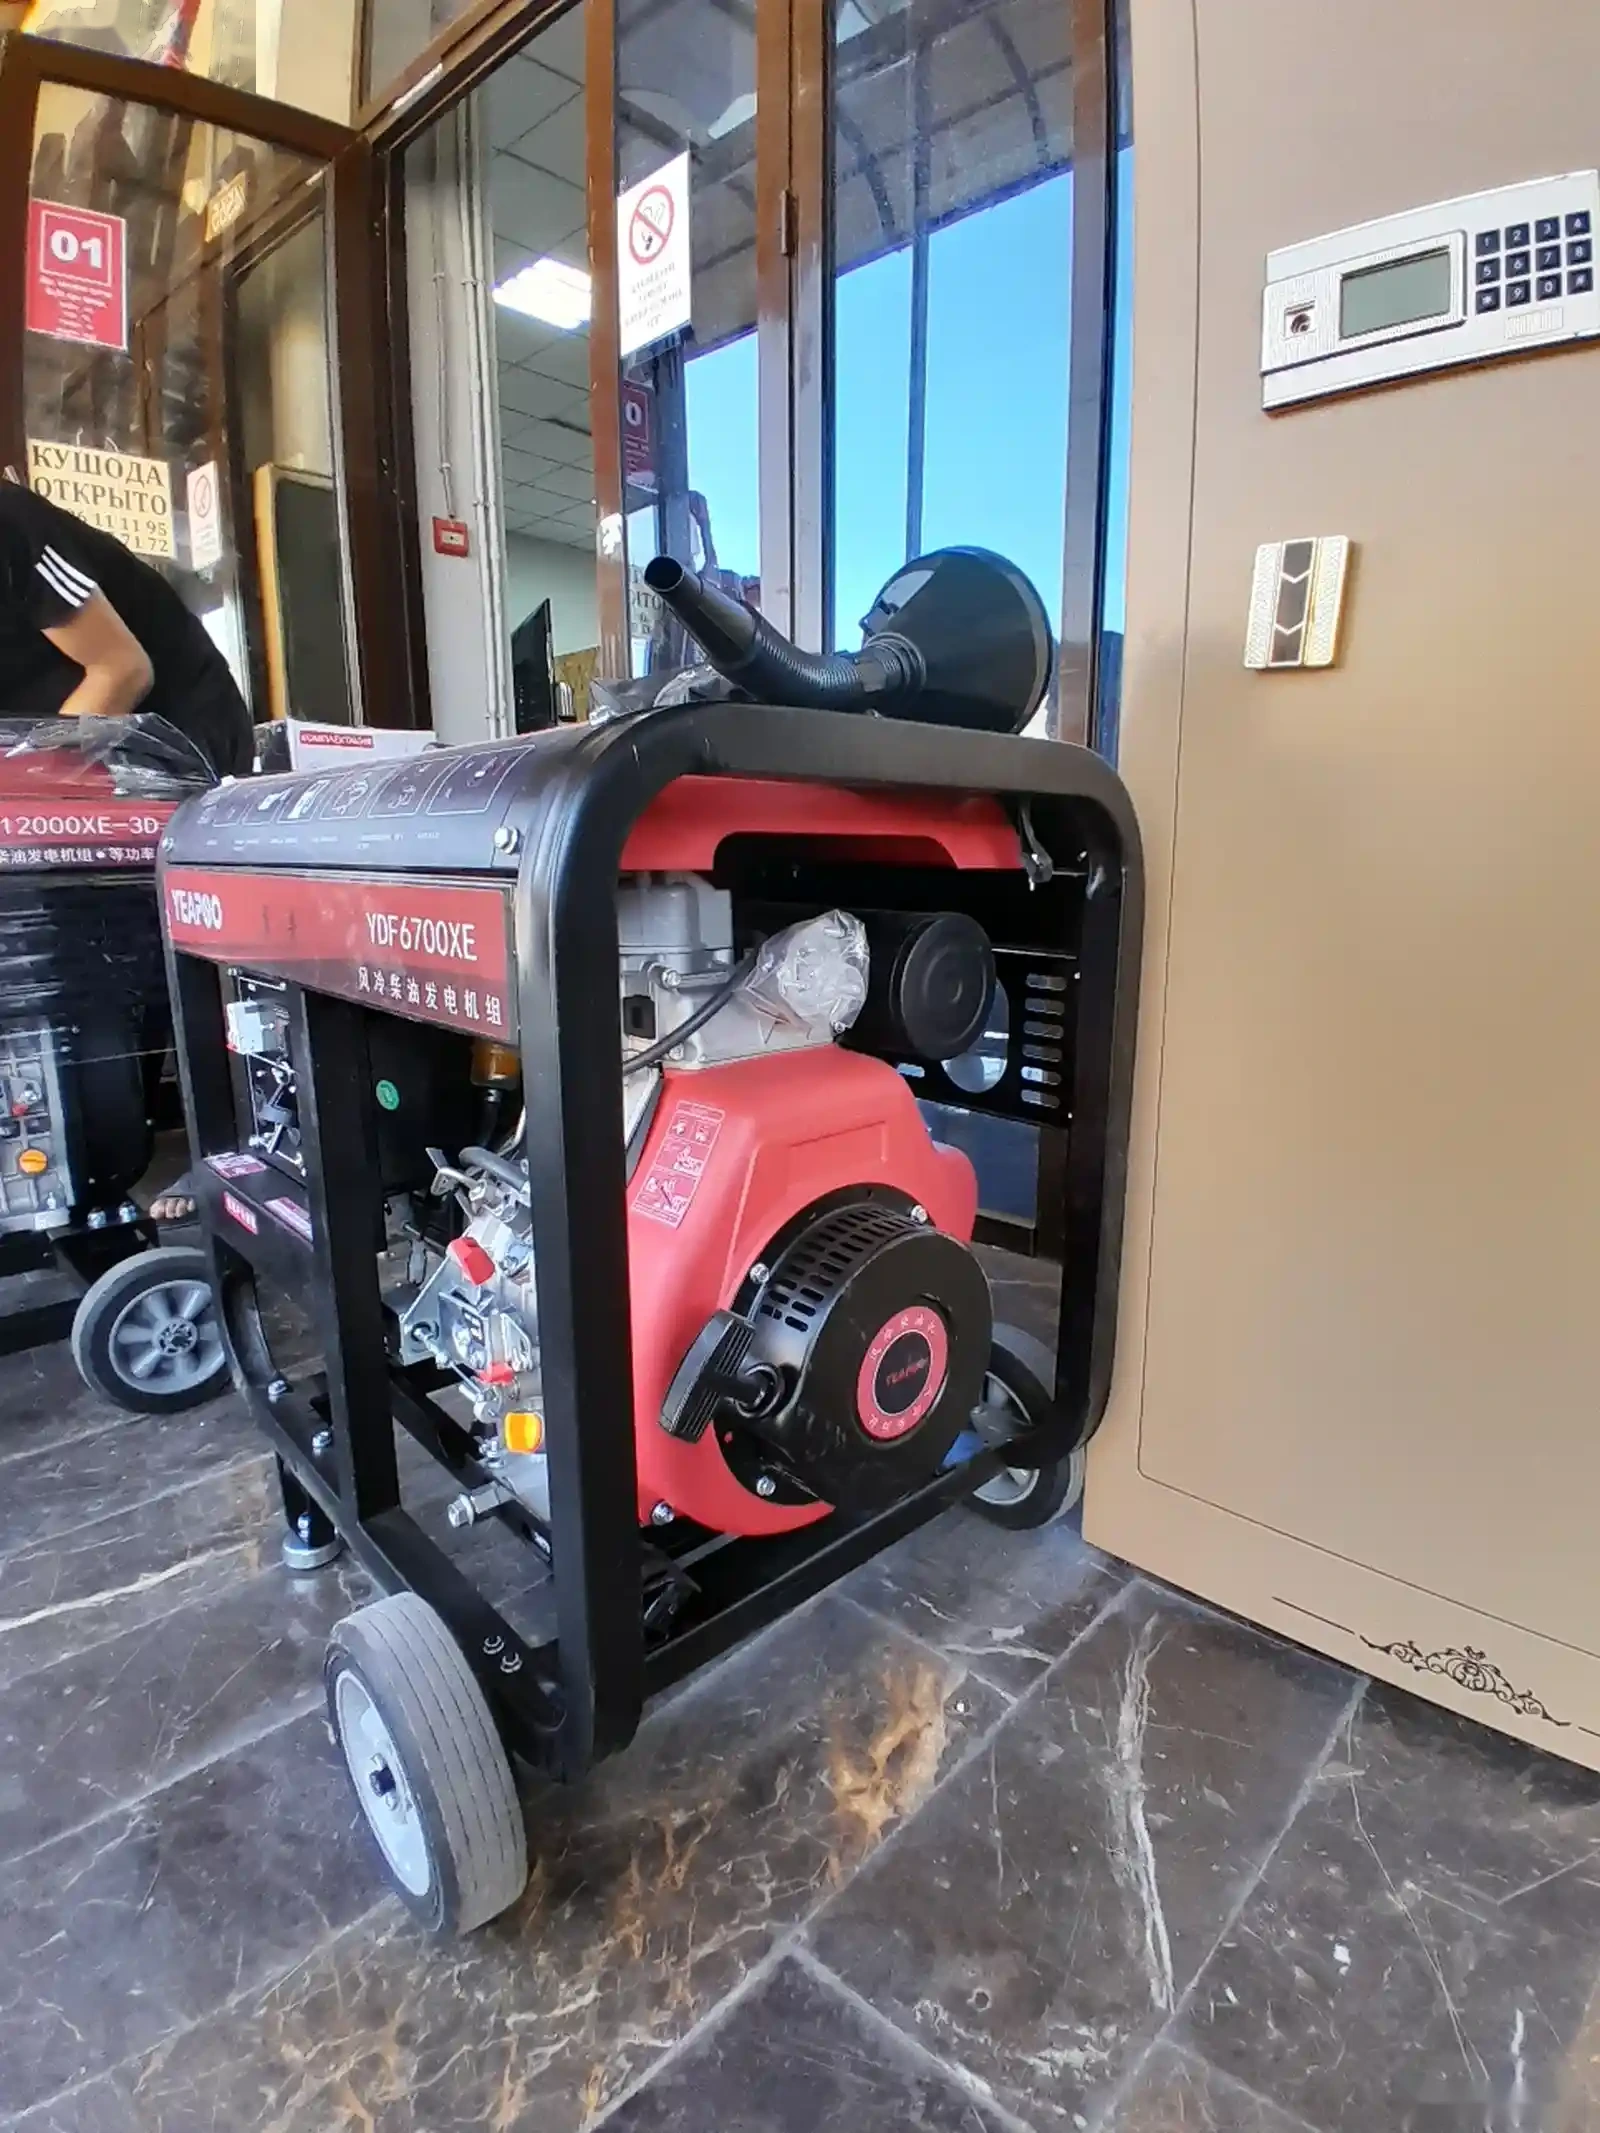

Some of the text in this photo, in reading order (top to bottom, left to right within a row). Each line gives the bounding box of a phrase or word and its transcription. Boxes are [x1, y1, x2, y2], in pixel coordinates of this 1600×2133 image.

[50, 229, 103, 269] 01
[1512, 228, 1522, 242] 2
[1543, 222, 1552, 235] 3
[1483, 265, 1492, 278] 5
[1544, 250, 1553, 265] 7
[1543, 280, 1554, 293] 0
[32, 444, 165, 488] КУШОДА
[33, 476, 168, 516] ОТКРЫТО
[146, 519, 168, 536] 95
[365, 911, 478, 961] YDF6700XE
